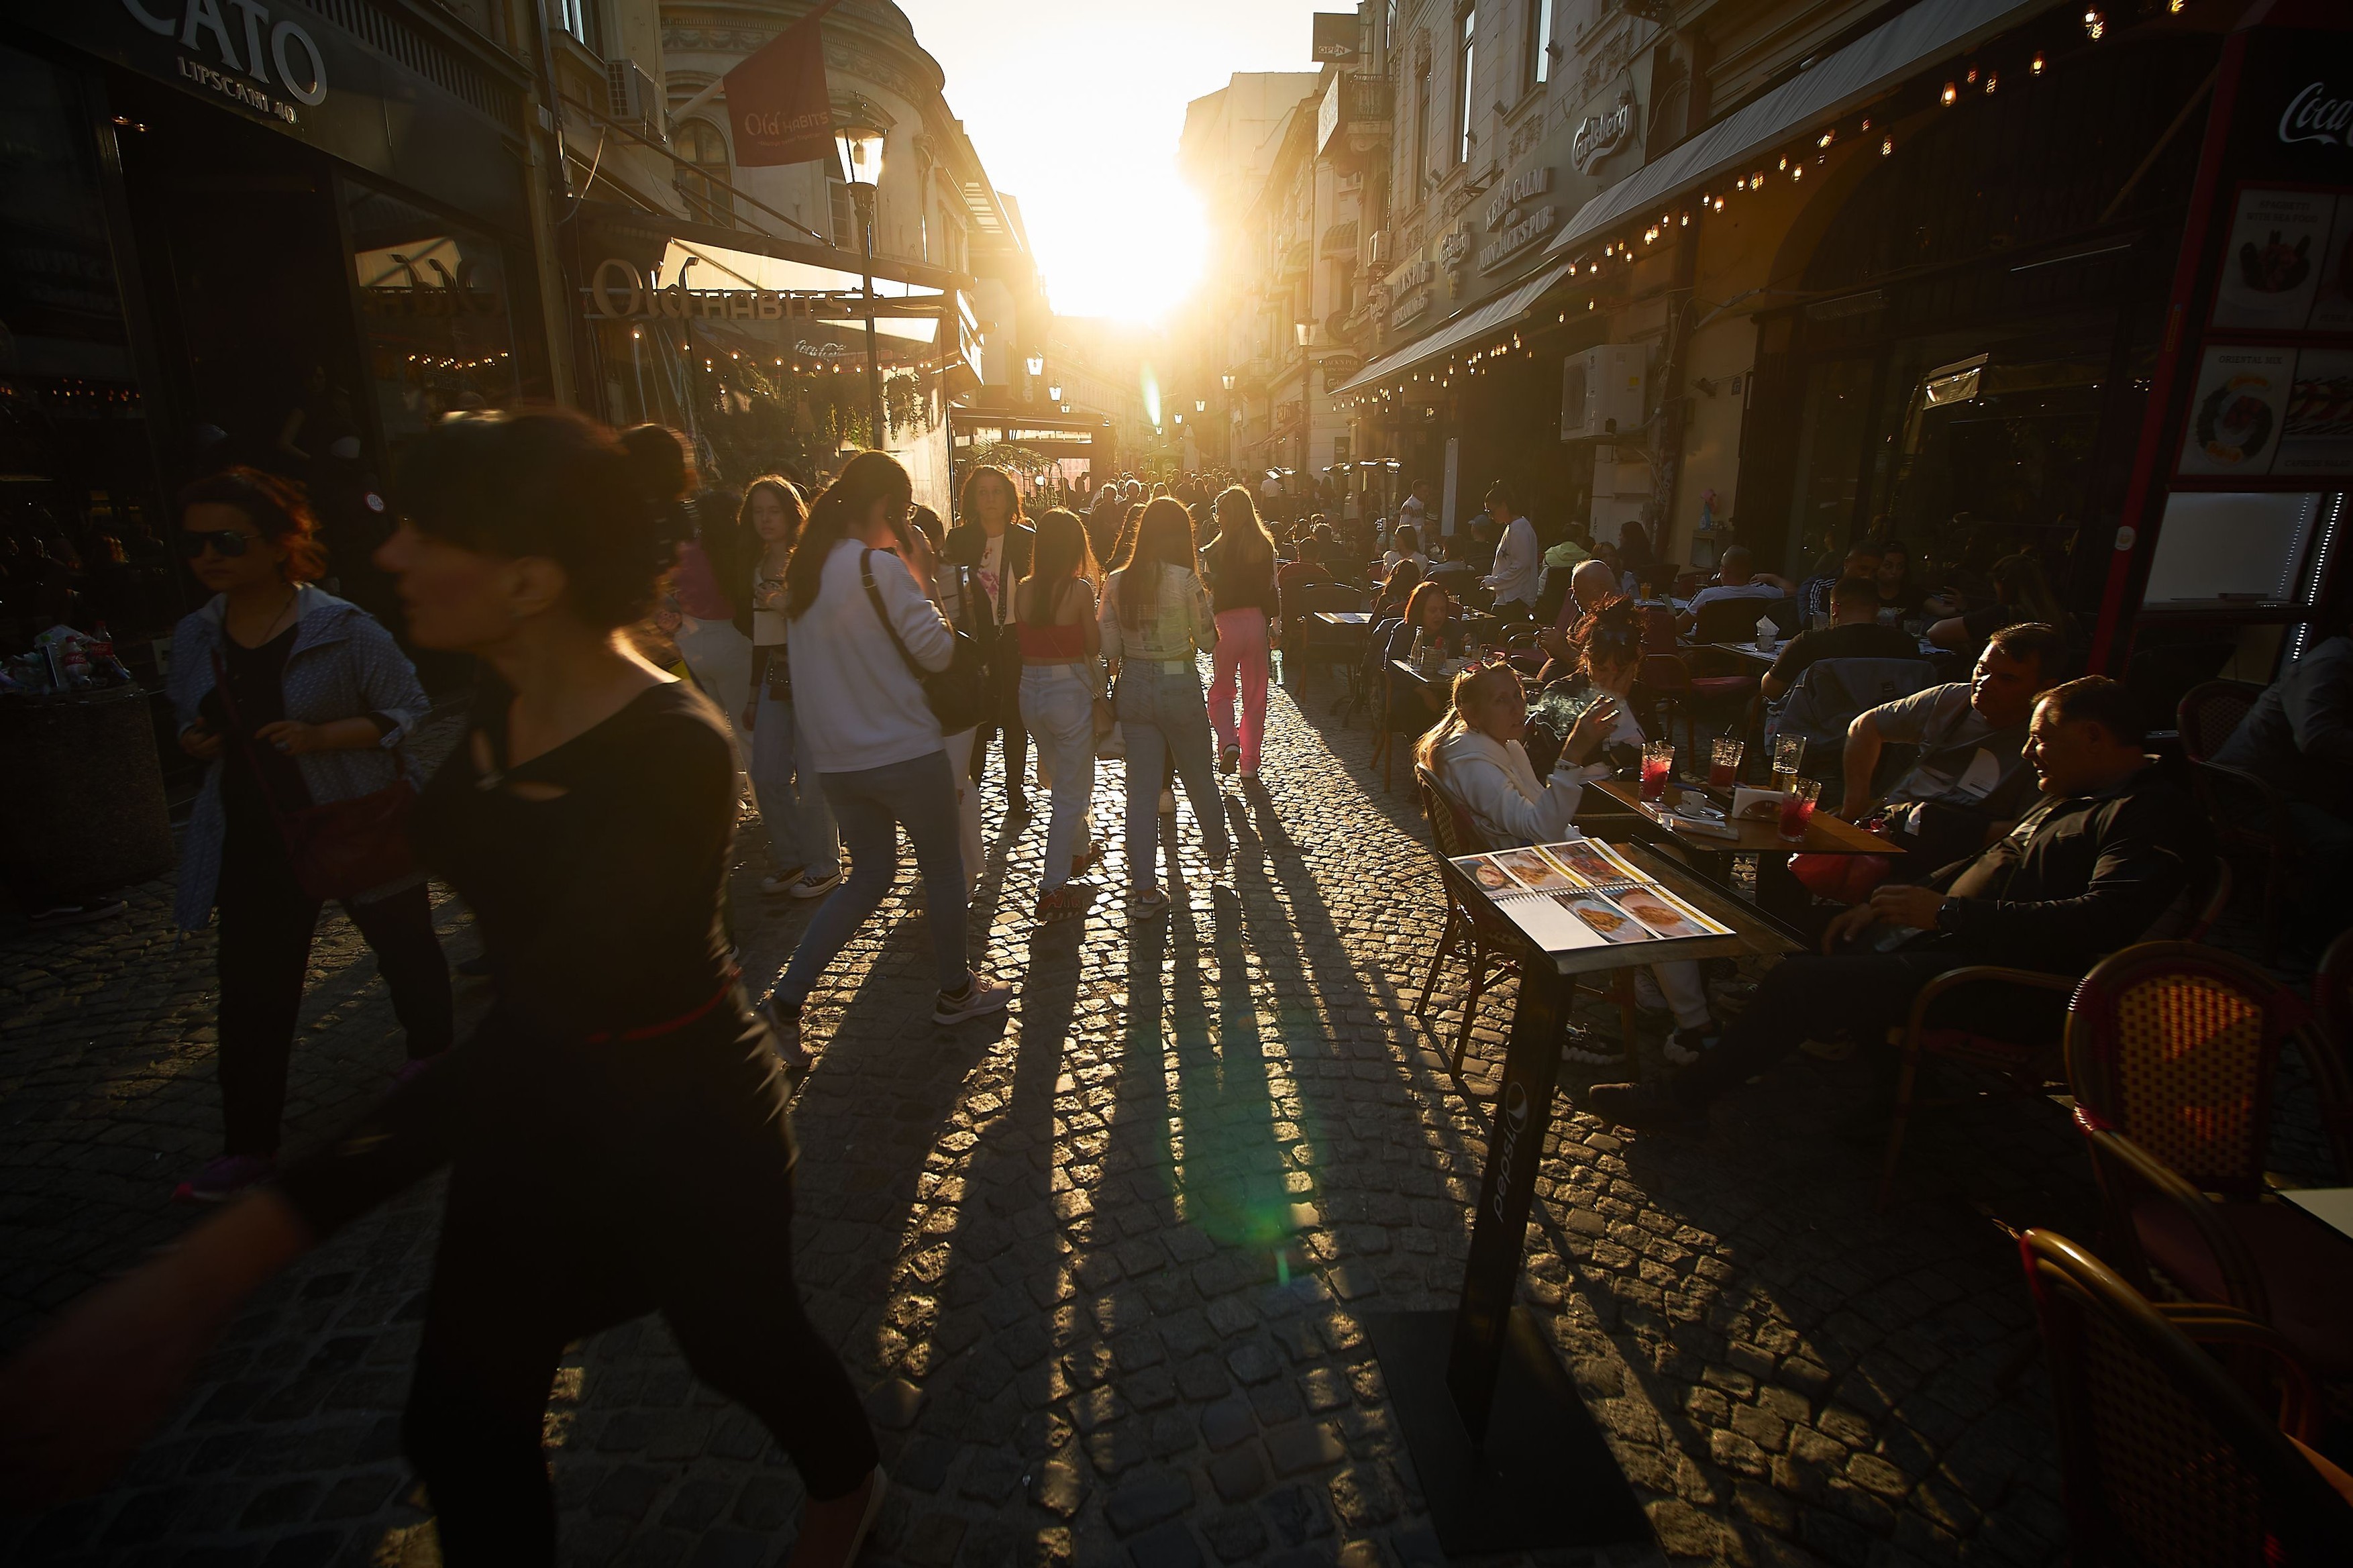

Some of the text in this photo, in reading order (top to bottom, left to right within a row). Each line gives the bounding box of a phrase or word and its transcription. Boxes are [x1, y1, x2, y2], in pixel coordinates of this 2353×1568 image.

[177, 56, 298, 124] LIPSCANI 40
[745, 111, 829, 136] Old HABITS
[1571, 104, 1629, 176] Carlsberg
[1485, 166, 1546, 232] KEEP CALM
[1504, 209, 1516, 227] AND
[2246, 212, 2318, 223] WITH SEA FOOD
[2259, 200, 2310, 211] SPAGHETTI
[1439, 233, 1467, 274] Carlsberg
[1477, 205, 1551, 272] JOIN JACK'S PUB
[592, 256, 850, 320] Old HABITS
[1412, 261, 1427, 286] PUB
[2218, 355, 2283, 364] ORIENTAL MIX
[1493, 1127, 1518, 1224] pepsi
